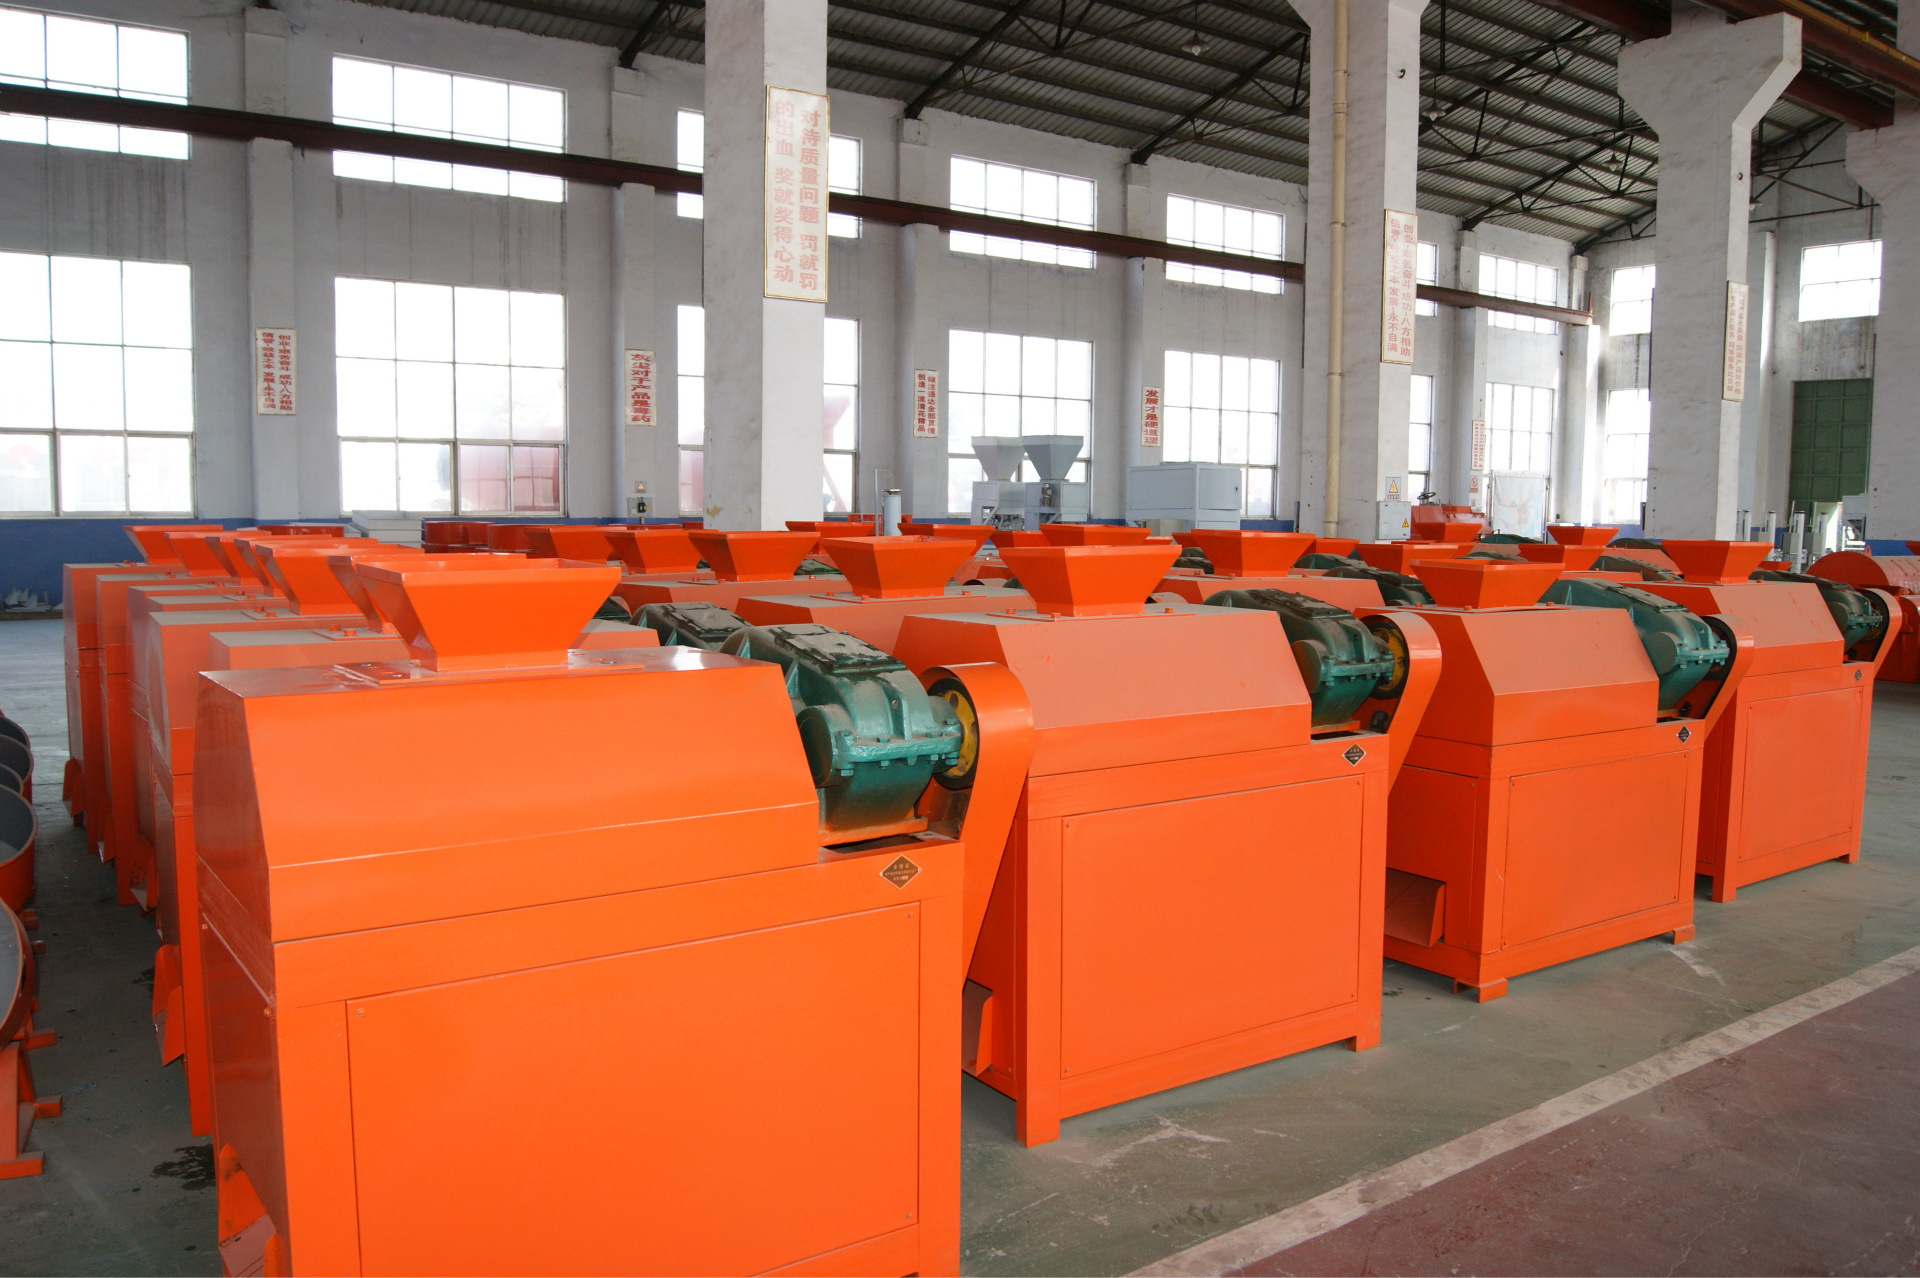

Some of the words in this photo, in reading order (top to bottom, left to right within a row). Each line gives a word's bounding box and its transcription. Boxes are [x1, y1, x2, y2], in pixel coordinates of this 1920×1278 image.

[774, 99, 795, 157] 的出血
[799, 109, 821, 225] 对待质量问题
[774, 167, 795, 283] 奖就奖得心动
[799, 234, 819, 290] 罚就罚
[630, 353, 652, 423] 灰尘对于产品是毒药
[1144, 389, 1159, 444] 发展才是硬道理
